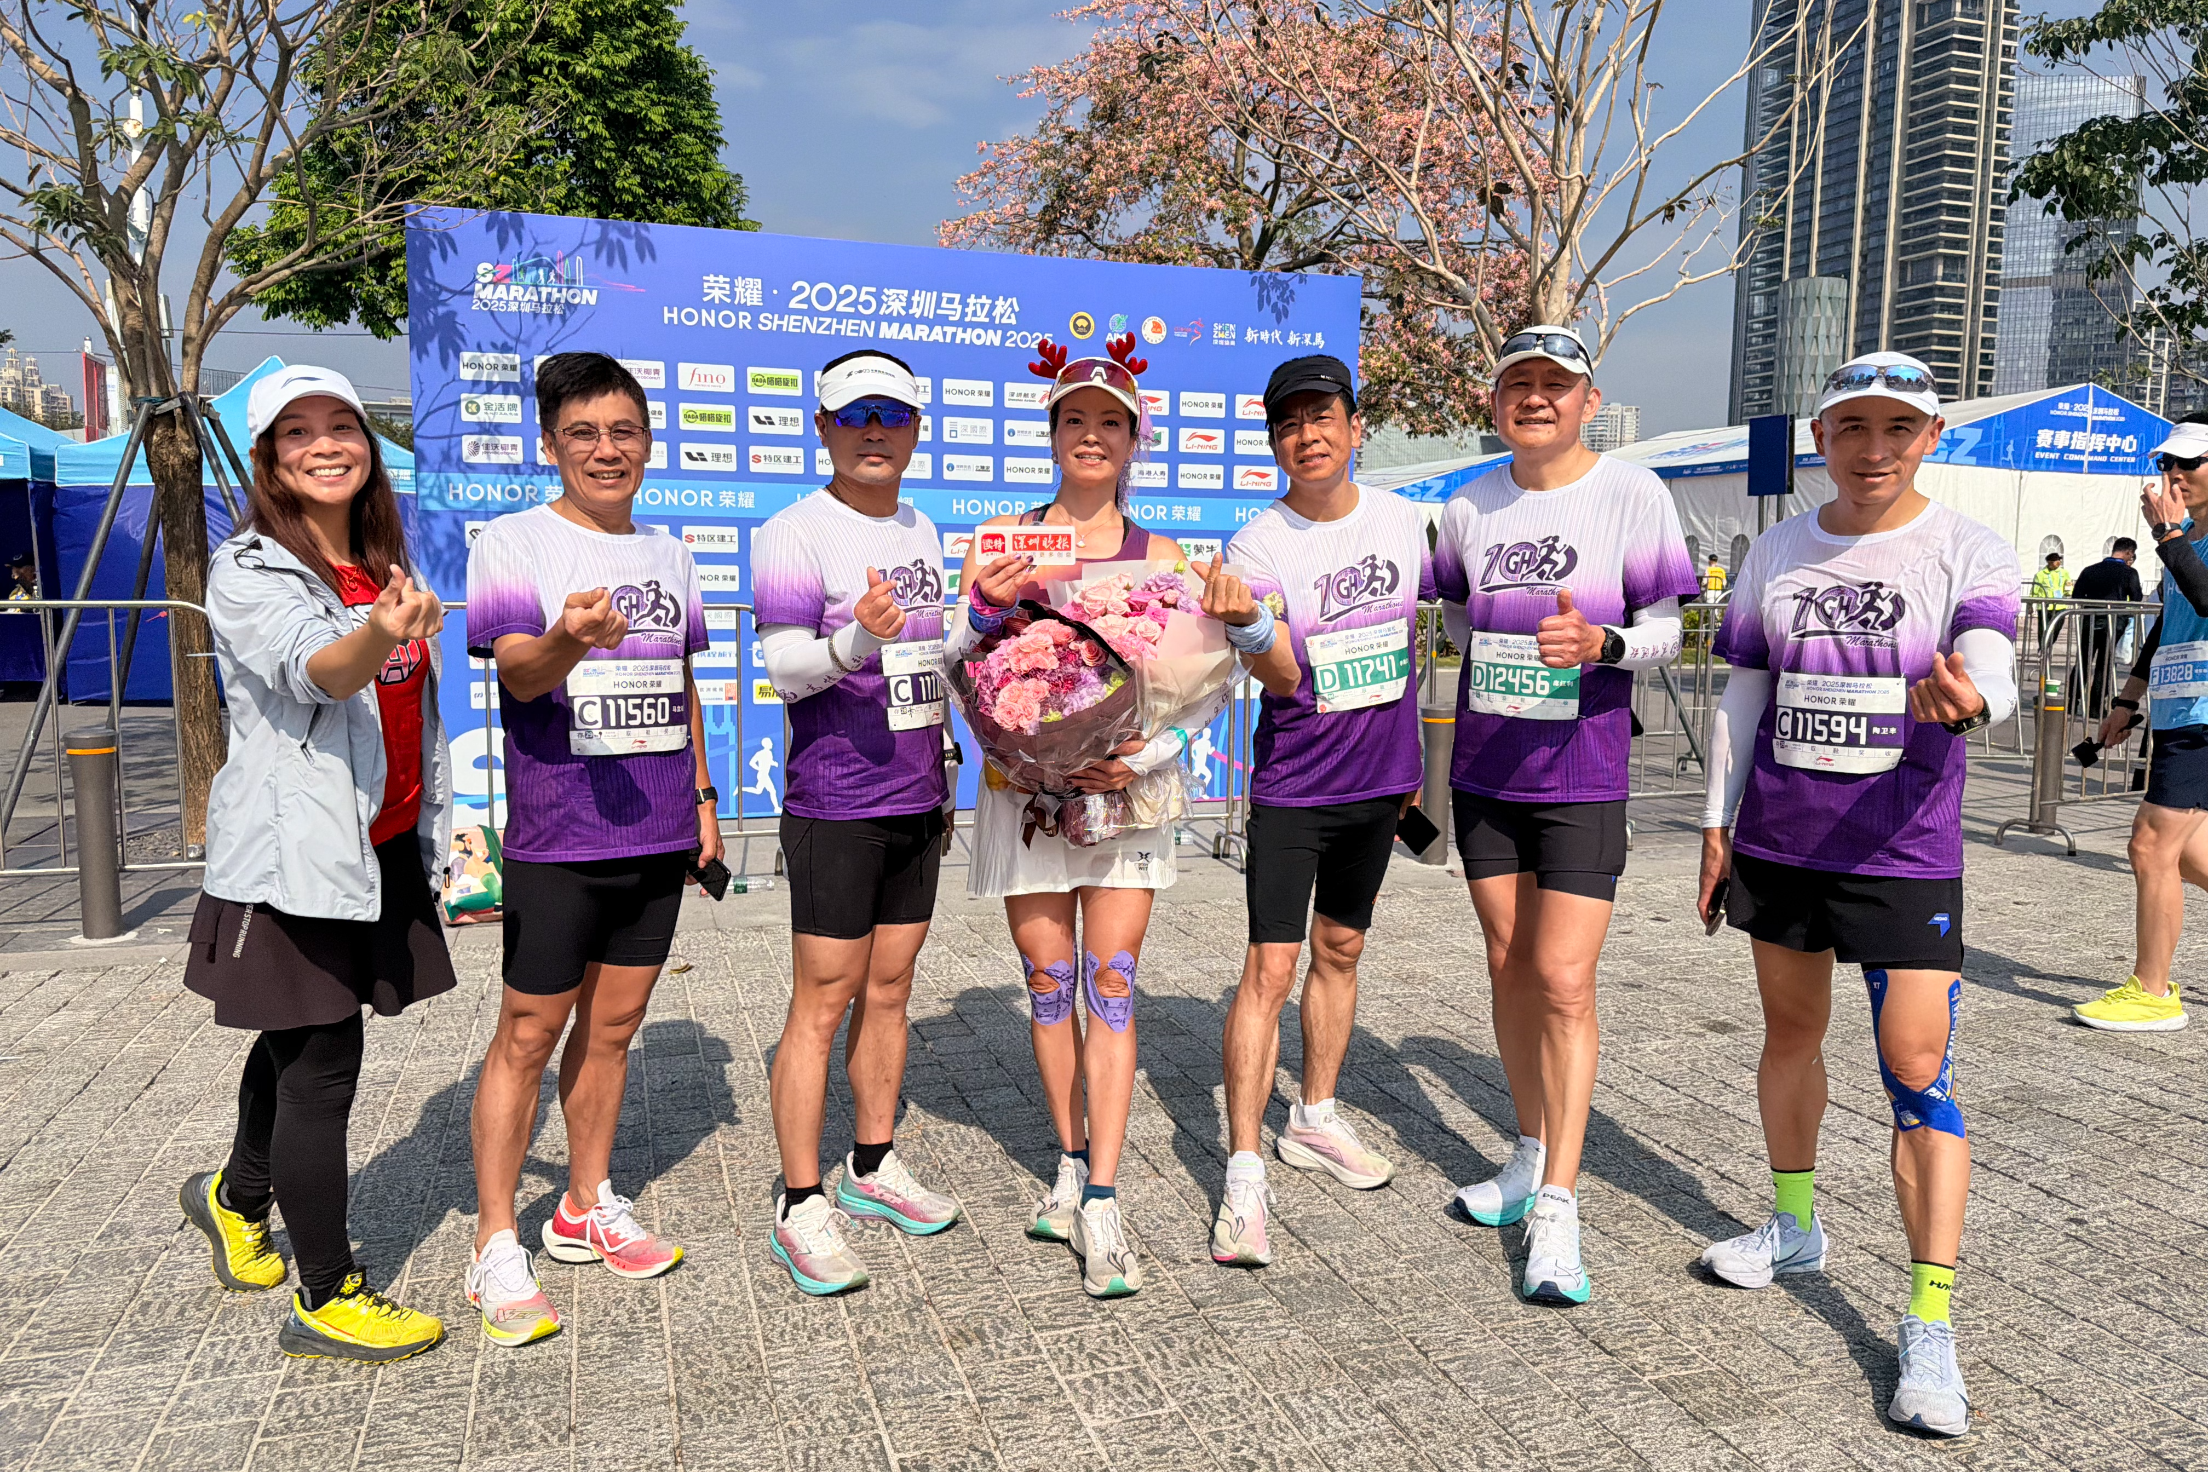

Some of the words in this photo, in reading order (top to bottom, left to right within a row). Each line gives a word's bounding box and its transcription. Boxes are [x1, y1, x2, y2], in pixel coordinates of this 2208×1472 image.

[473, 284, 598, 306] MARATHON
[471, 299, 565, 315] 2025深圳马拉松
[663, 306, 753, 330] HONOR
[757, 312, 876, 338] SHENZHEN
[878, 321, 1003, 347] MARATHON
[1004, 331, 1053, 349] 2025
[1212, 322, 1236, 332] SHEN
[462, 361, 499, 372] HONOR
[501, 364, 518, 372] 荣耀
[687, 367, 726, 386] fino
[945, 388, 976, 397] HONOR
[977, 390, 991, 398] 荣耀
[1181, 400, 1210, 409] HONOR
[778, 416, 800, 428] 理想
[1236, 439, 1263, 447] HONOR
[2035, 429, 2137, 453] 赛事指挥中心
[711, 452, 733, 464] 理想
[763, 454, 802, 464] 特区建工
[2034, 451, 2061, 460] EVENT
[2110, 455, 2136, 463] CENTER
[1006, 466, 1036, 474] HONOR
[1037, 467, 1051, 475] 荣耀
[1180, 472, 1208, 480] HONOR
[1239, 480, 1272, 488] LI-NING
[448, 483, 538, 502] HONOR
[718, 490, 755, 509] 荣耀
[952, 499, 1026, 516] HONOR
[1129, 504, 1168, 520] NOR
[1171, 505, 1202, 522] 荣耀
[696, 533, 737, 543] 特区建工
[1013, 534, 1070, 551] 深圳晚报
[1193, 543, 1217, 557] 蒙牛
[721, 575, 737, 583] 荣耀
[1345, 643, 1375, 655] HONOR
[1846, 635, 1897, 649] Marathons
[1496, 651, 1525, 661] HONOR
[1319, 667, 1337, 691] D
[1344, 654, 1397, 687] 11741
[1473, 664, 1485, 688] D
[1488, 666, 1551, 695] 12456
[2160, 663, 2193, 684] 13828
[614, 680, 648, 689] HONOR
[893, 678, 911, 703] C
[1804, 694, 1837, 705] HONOR
[1838, 697, 1856, 707] 荣耀
[577, 700, 599, 726] C
[606, 697, 670, 727] 11560
[1777, 711, 1790, 736] C
[1796, 711, 1868, 745] 11594
[241, 912, 252, 930] STOP
[233, 929, 248, 959] RUNNING
[1542, 1192, 1570, 1205] PEAK
